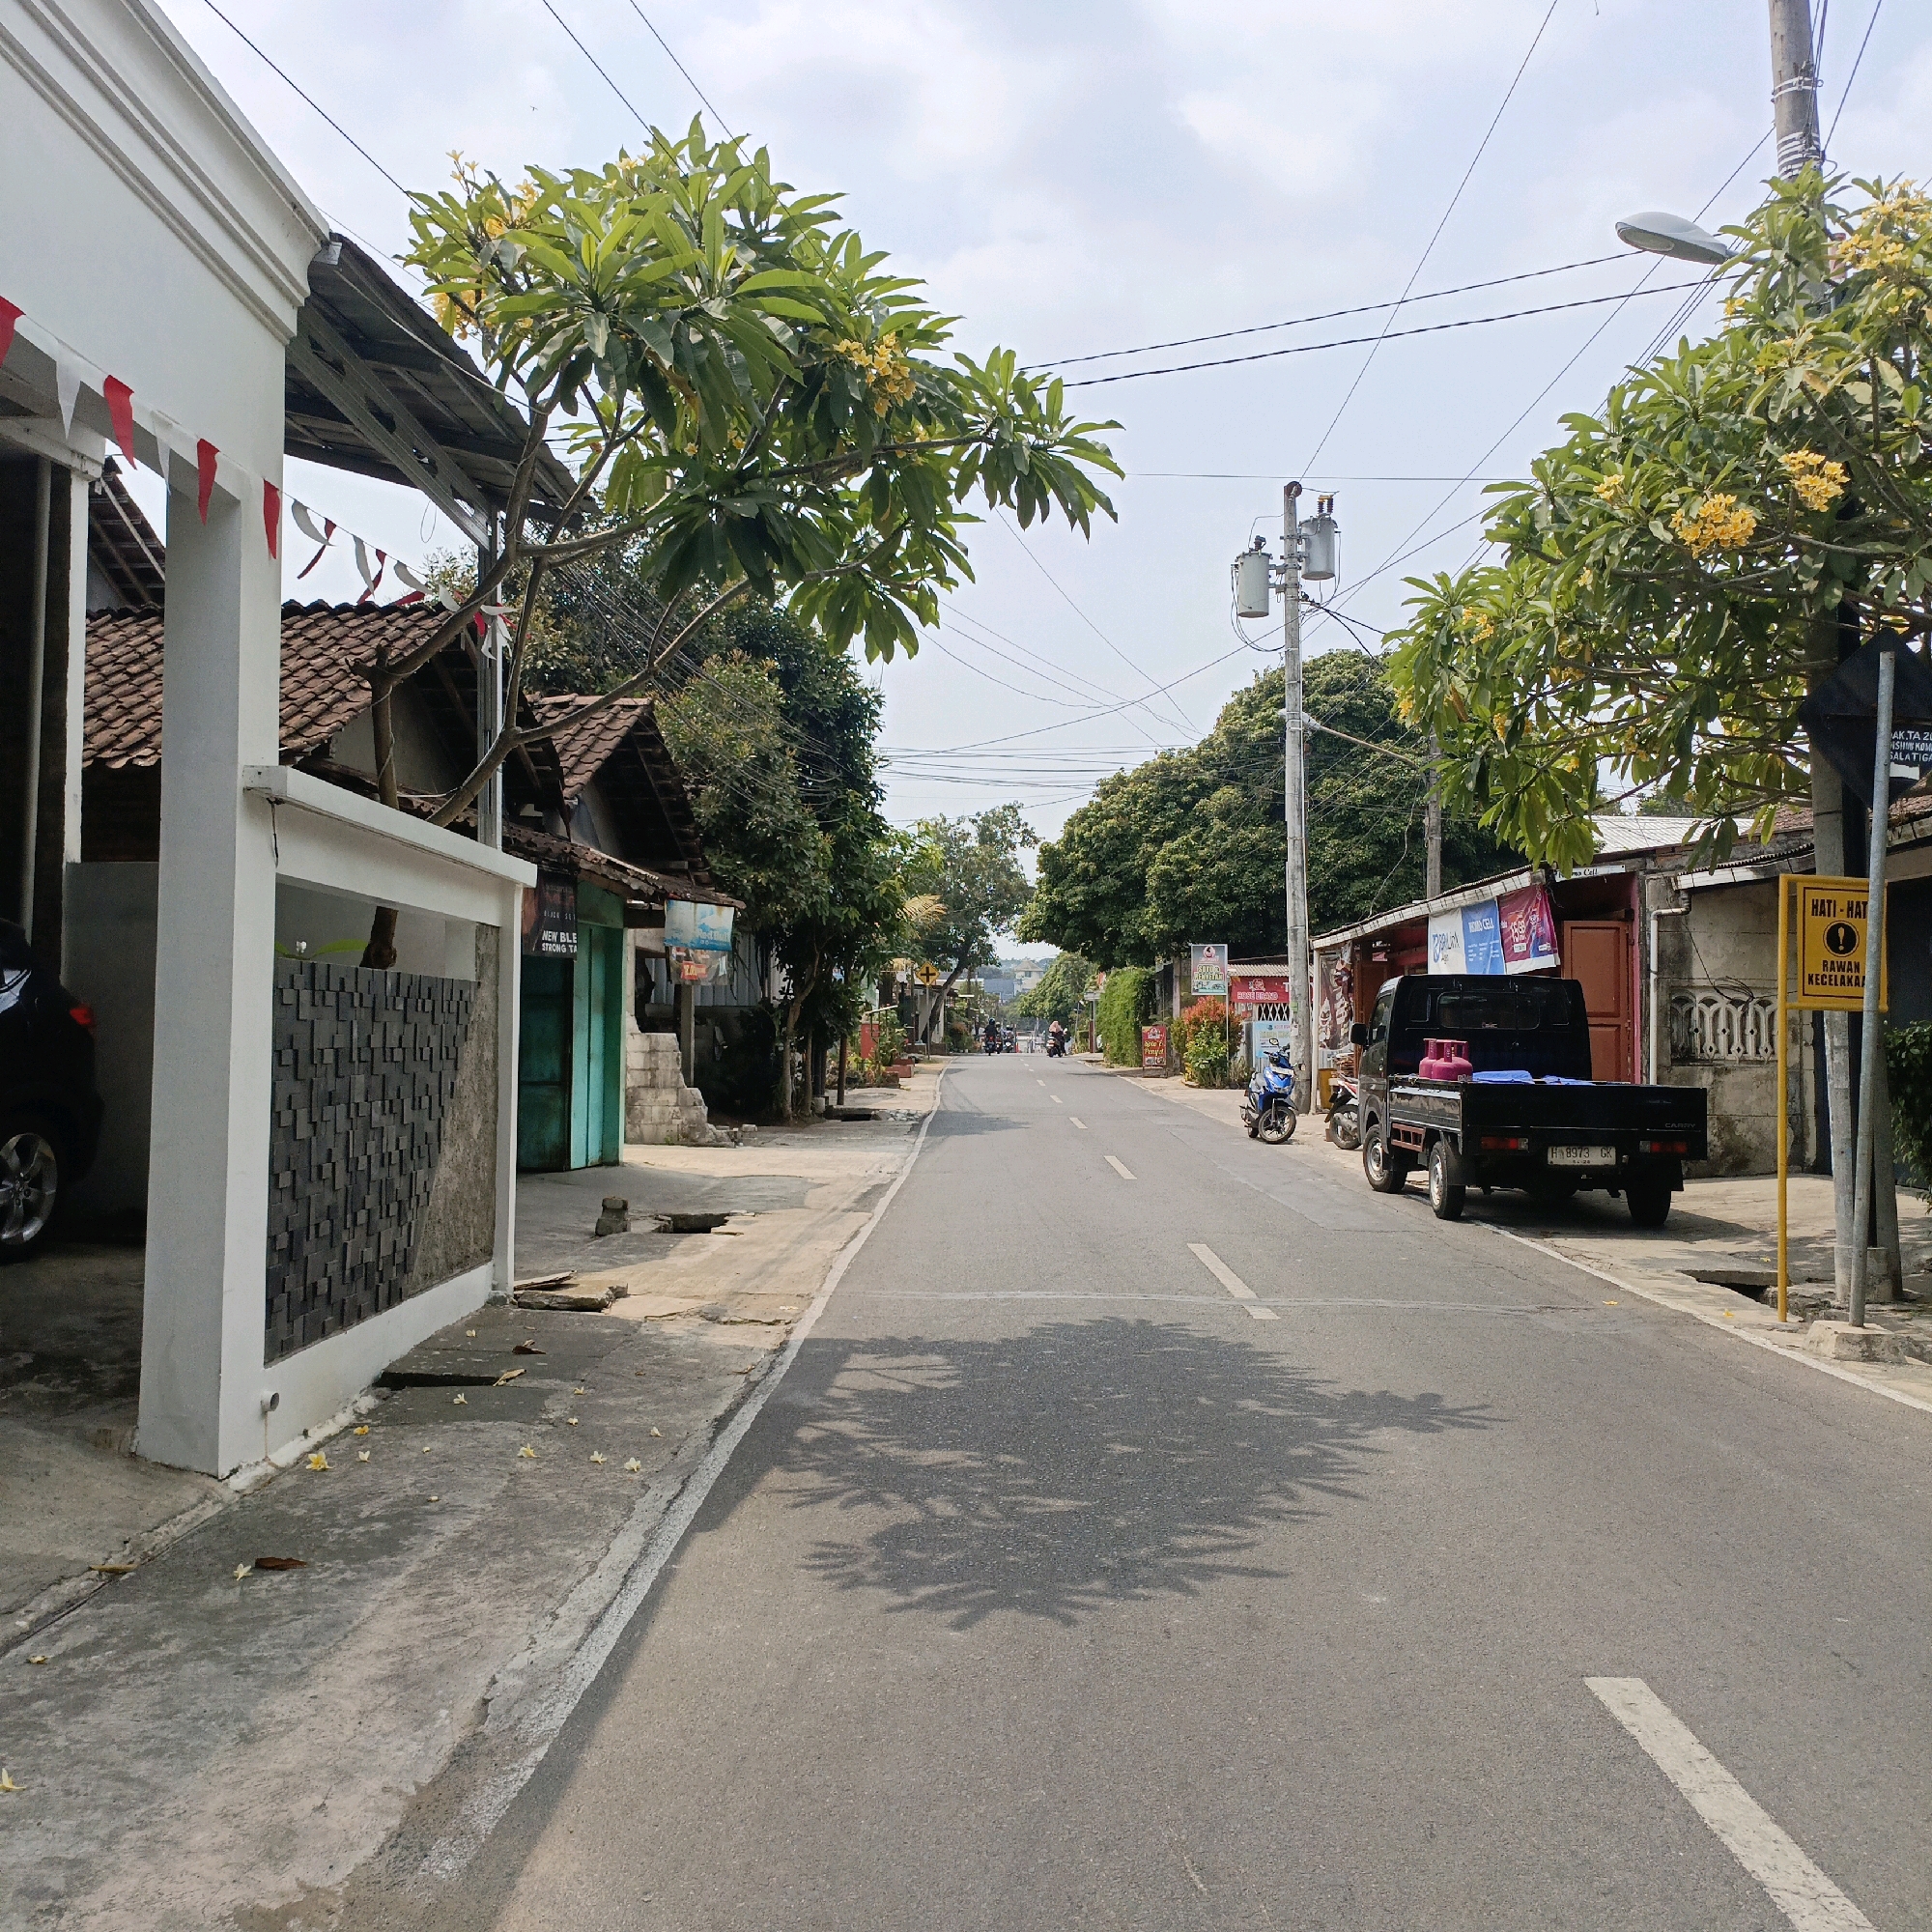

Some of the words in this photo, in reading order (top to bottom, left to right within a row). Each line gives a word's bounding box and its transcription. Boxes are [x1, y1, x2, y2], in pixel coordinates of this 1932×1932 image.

[1890, 730, 1921, 740] AK.TA
[1811, 898, 1837, 918] HATI
[542, 930, 558, 943] NEW
[542, 943, 567, 953] STRONG
[1822, 960, 1861, 974] RAWAN
[1550, 1147, 1558, 1158] H
[1565, 1147, 1591, 1158] 8973
[1600, 1147, 1613, 1158] GK
